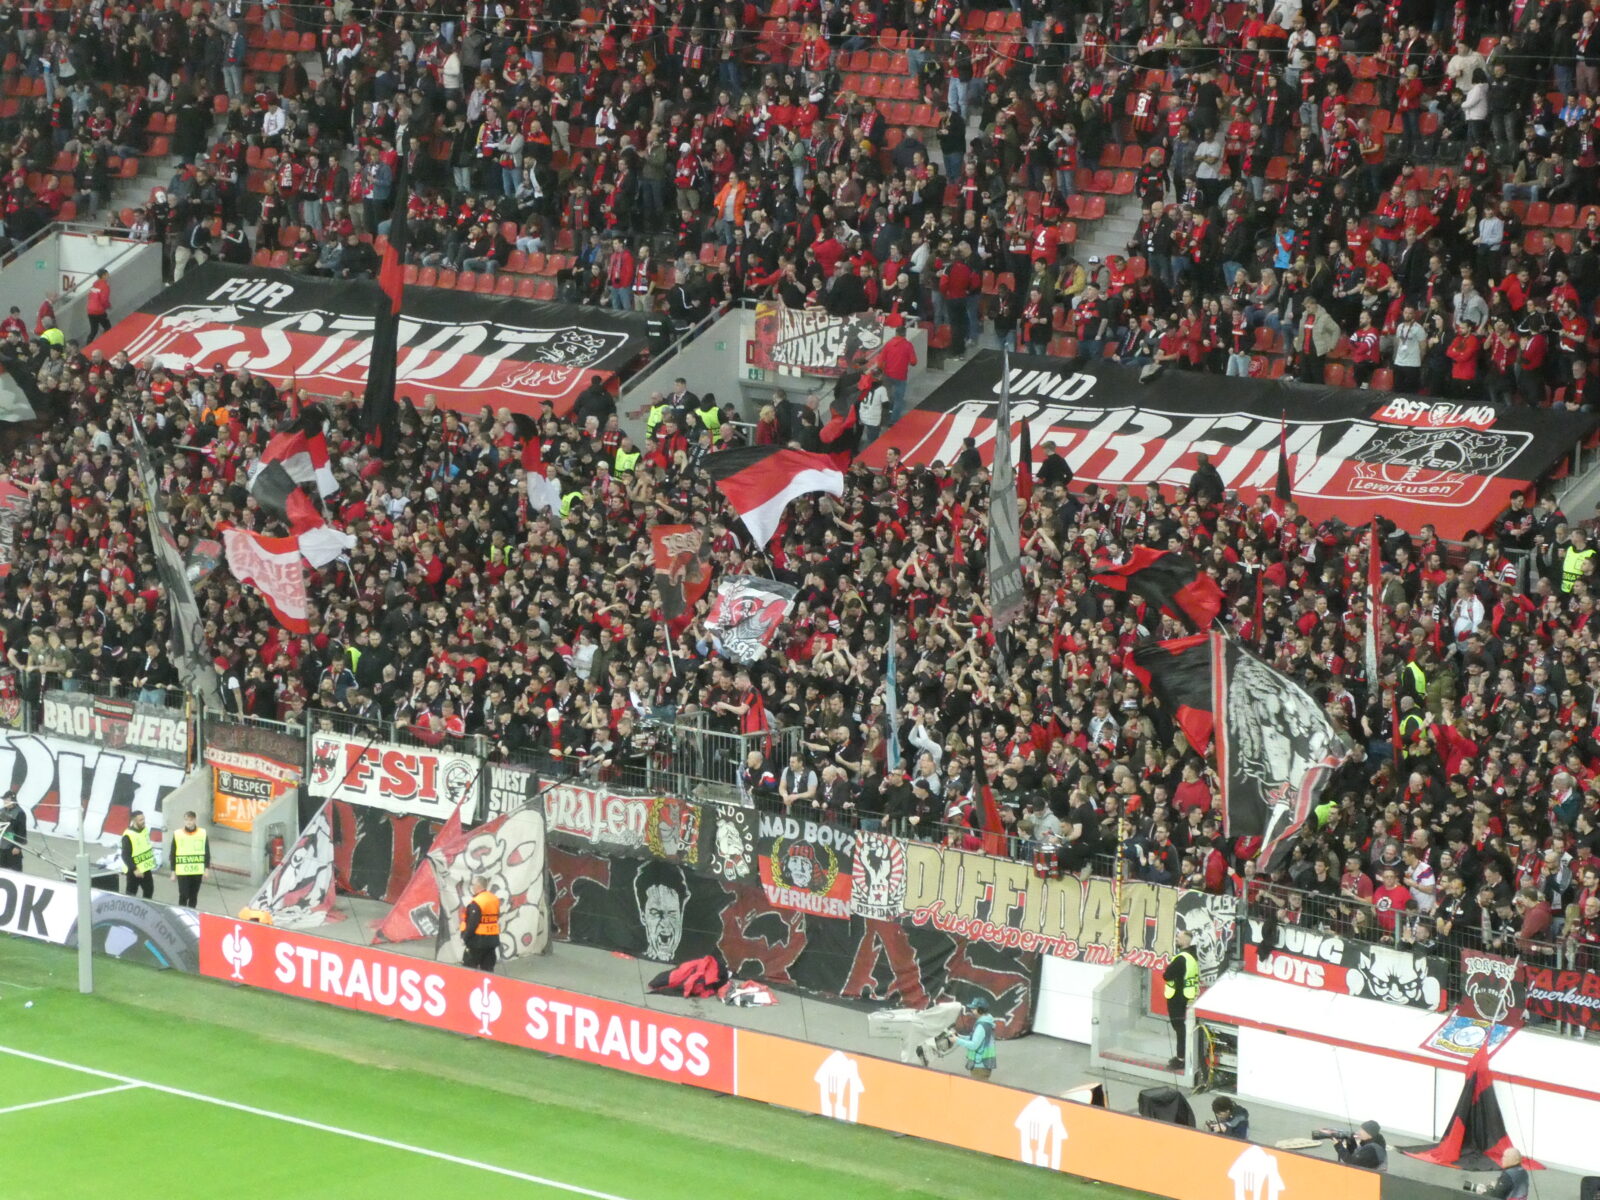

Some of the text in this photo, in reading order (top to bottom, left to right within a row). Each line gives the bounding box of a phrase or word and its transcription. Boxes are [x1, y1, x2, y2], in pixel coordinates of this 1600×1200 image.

[206, 277, 294, 309] FÜR
[227, 311, 556, 389] STADT
[993, 368, 1098, 401] UND
[930, 402, 1380, 494] VEREIN
[1354, 478, 1452, 495] Leverkusen
[233, 778, 273, 795] RESPECT
[343, 743, 439, 804] FSI
[491, 766, 530, 793] WEST
[759, 815, 800, 840] MAD
[903, 843, 1179, 957] DIFFIDATI
[912, 901, 1079, 960] Ausgesperrte
[274, 941, 447, 1017] STRAUSS
[525, 996, 711, 1077] STRAUSS
